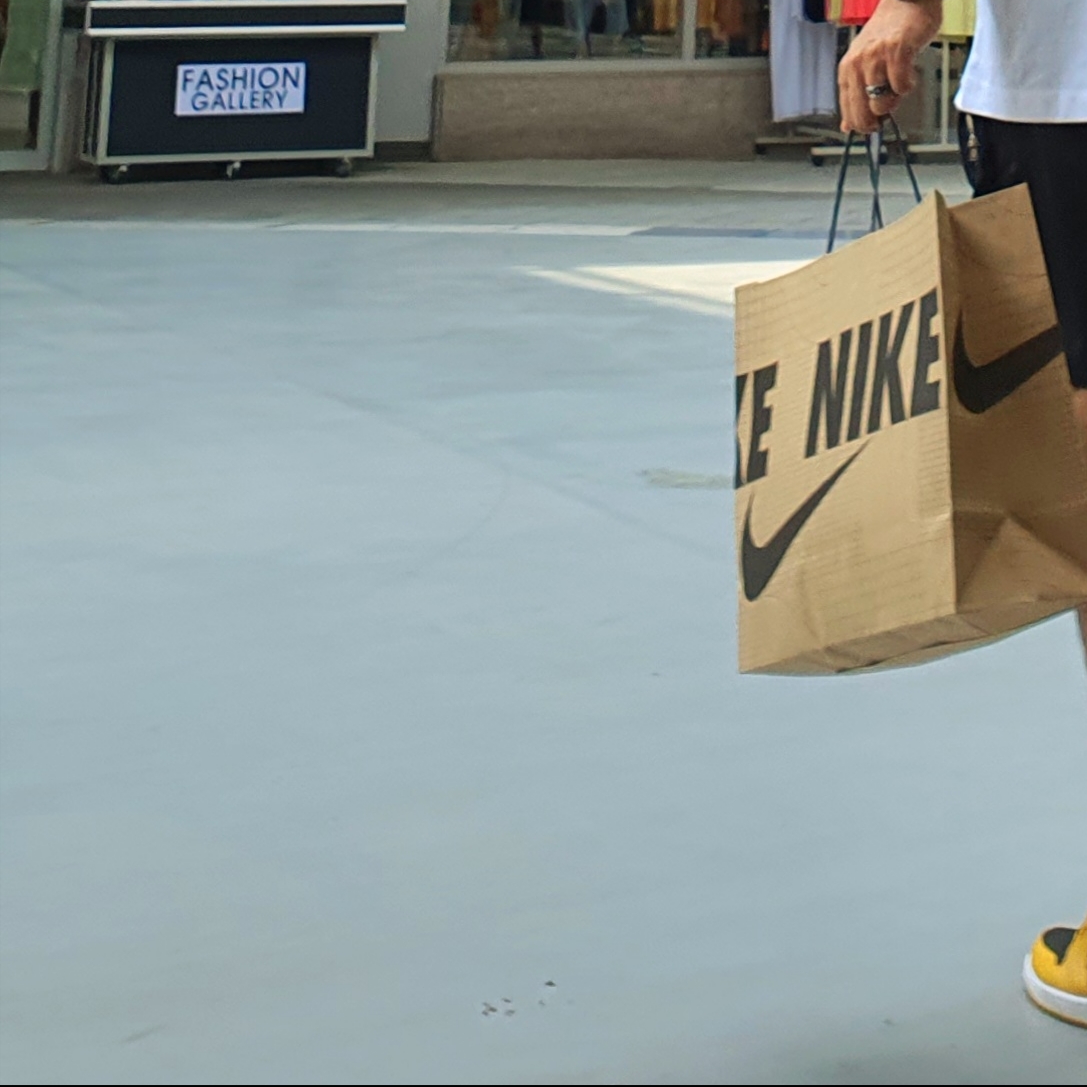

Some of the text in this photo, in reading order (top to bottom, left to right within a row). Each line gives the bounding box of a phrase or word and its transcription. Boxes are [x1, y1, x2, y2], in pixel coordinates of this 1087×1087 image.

[182, 66, 300, 92] FASHION
[191, 90, 289, 112] GALLERY
[804, 285, 941, 460] NIKE
